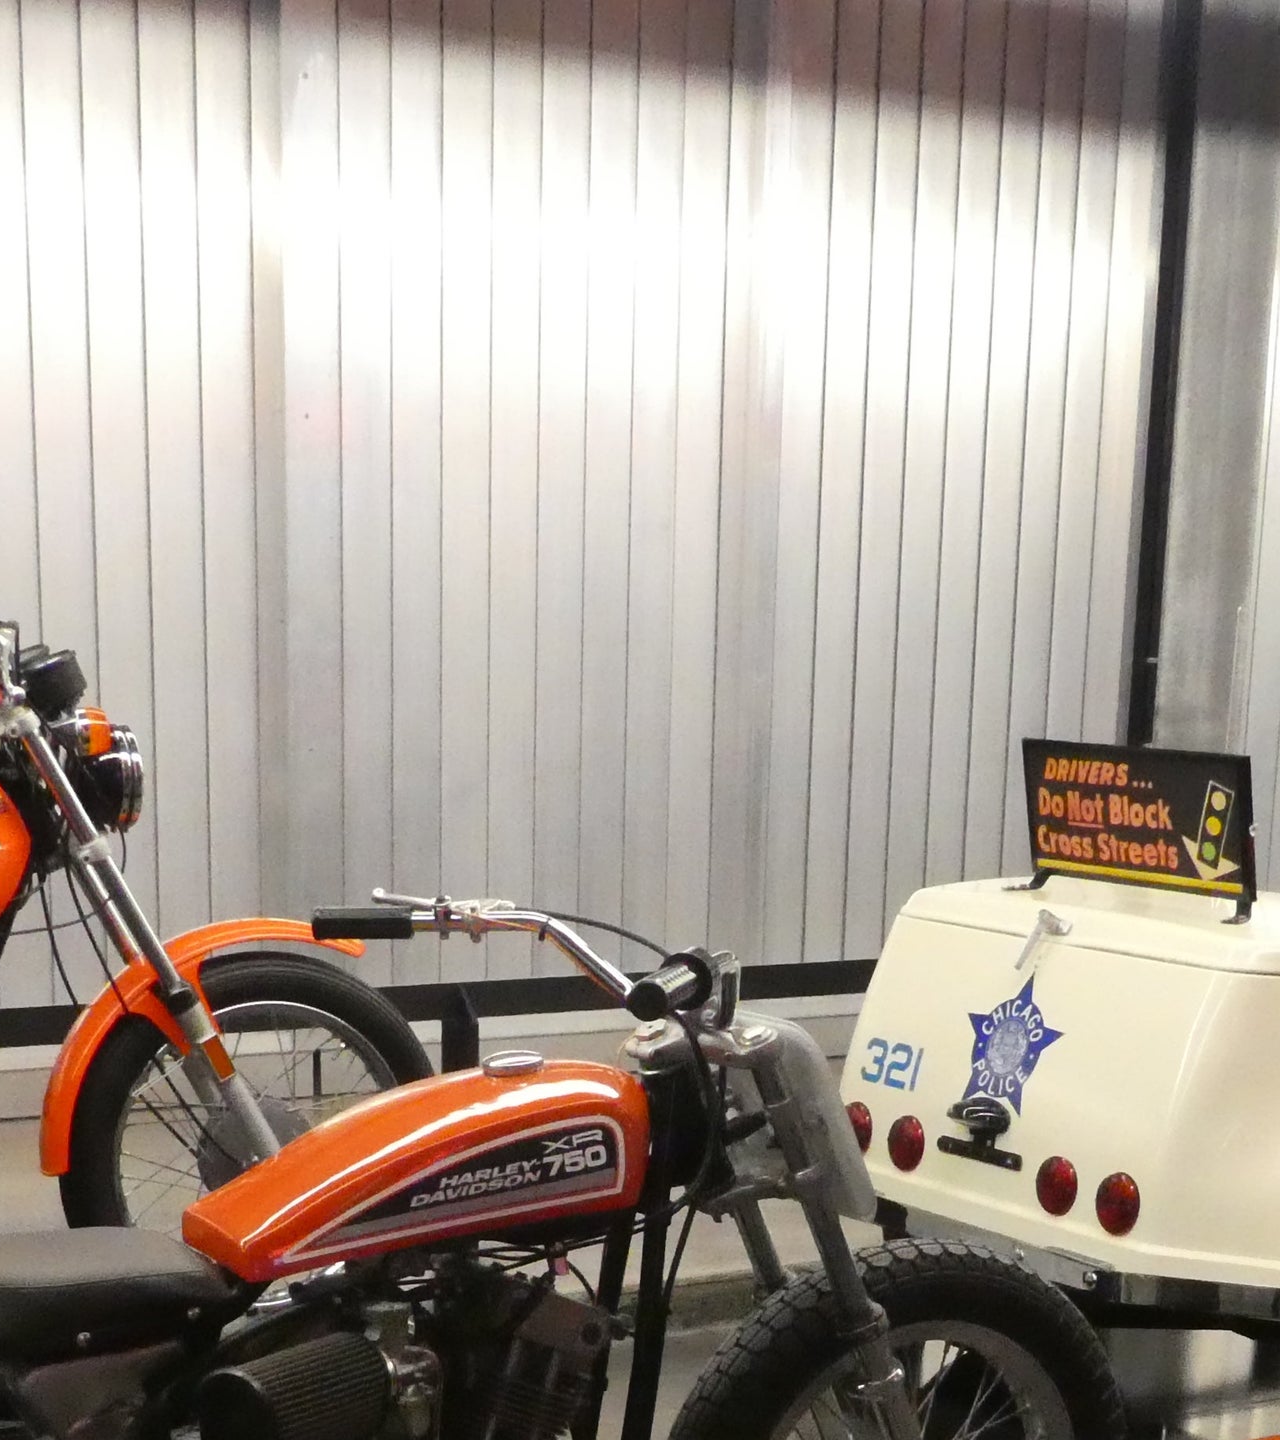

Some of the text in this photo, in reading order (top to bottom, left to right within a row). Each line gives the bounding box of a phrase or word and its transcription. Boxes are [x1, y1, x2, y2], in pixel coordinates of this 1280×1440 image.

[1038, 787, 1173, 830] Do Not Block
[1037, 824, 1179, 870] Cross Streets
[981, 999, 1043, 1043] CHICAGO
[860, 1037, 924, 1092] 321
[972, 1057, 1028, 1097] POLICE
[541, 1129, 603, 1154] XR
[542, 1144, 607, 1182] 750
[409, 1170, 541, 1208] DAVIDSON
